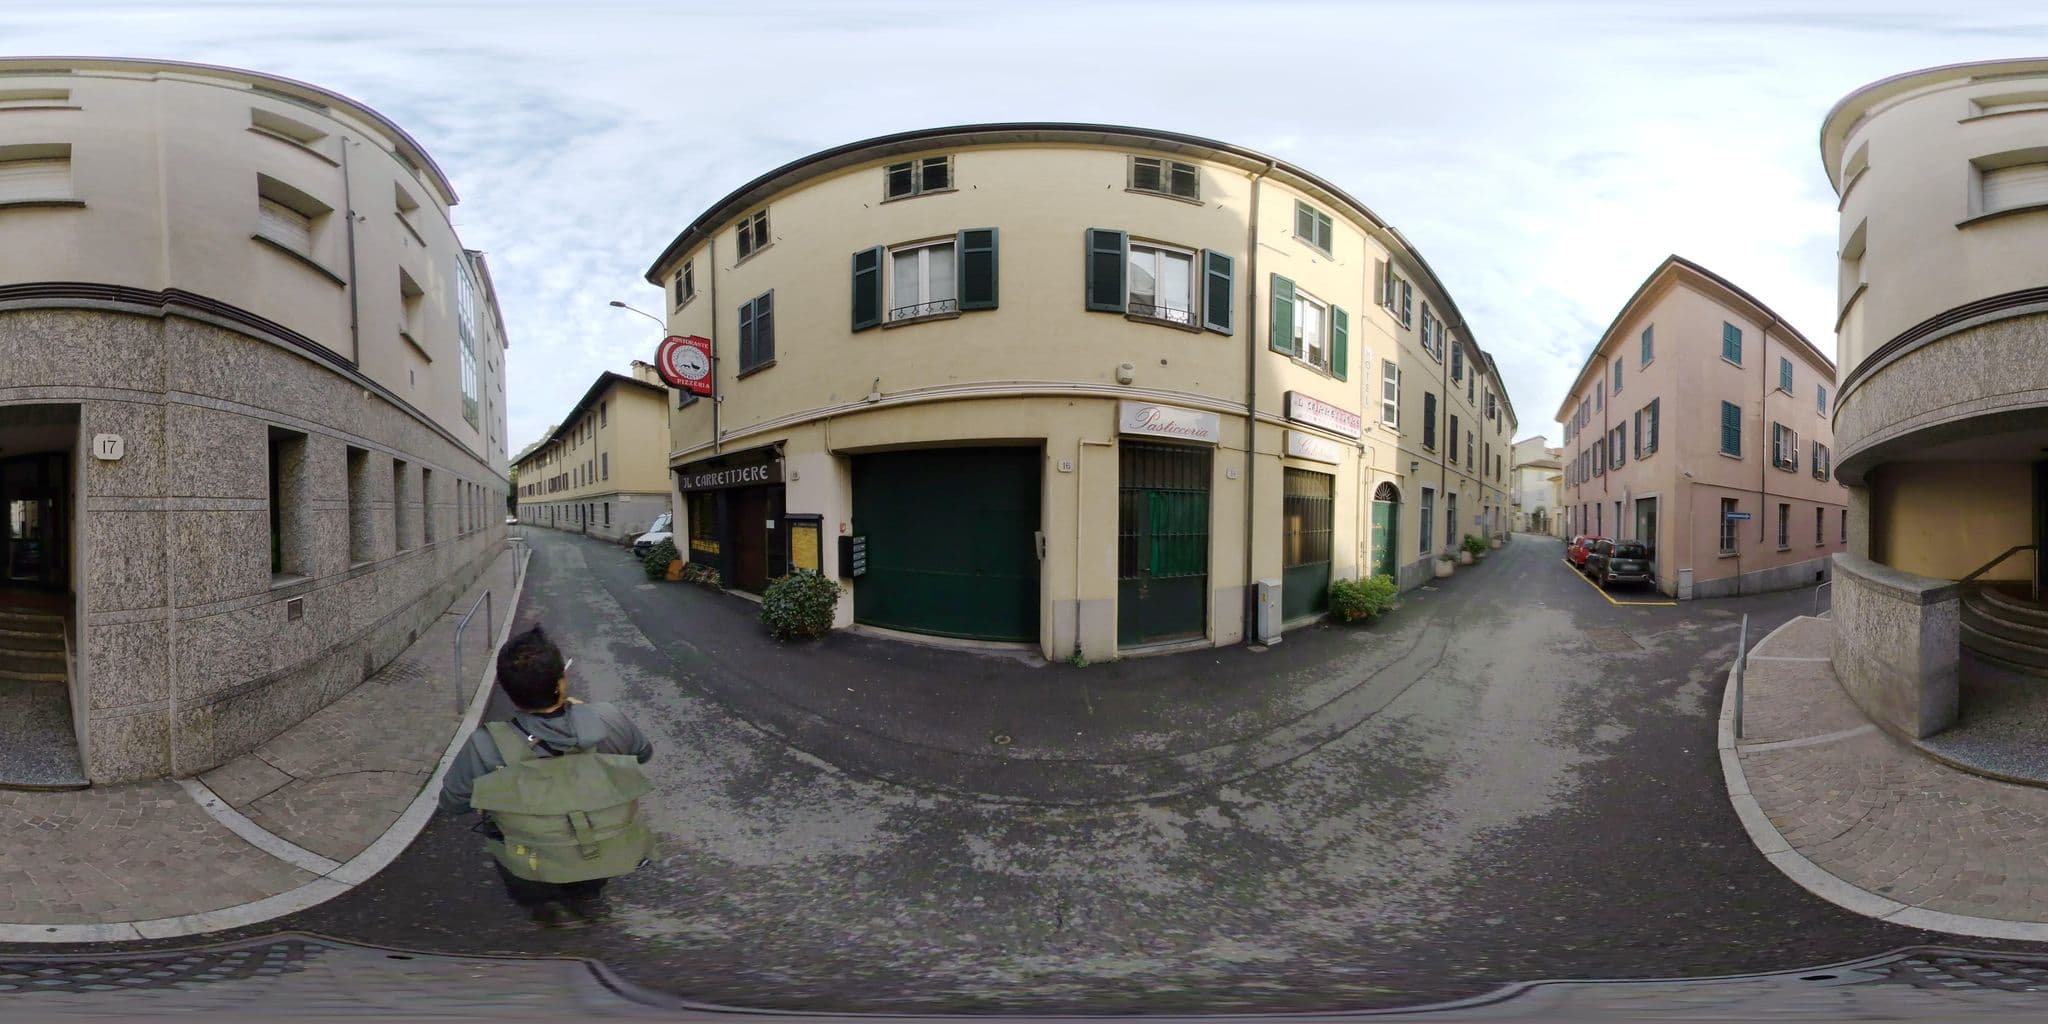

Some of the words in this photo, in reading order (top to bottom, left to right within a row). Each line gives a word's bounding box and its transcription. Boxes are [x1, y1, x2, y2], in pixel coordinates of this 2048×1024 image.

[677, 378, 710, 389] PIZZERIA
[1129, 407, 1209, 438] Pasticceria
[102, 440, 117, 454] 17
[1062, 461, 1071, 470] 16
[695, 465, 769, 487] CARRETTIERE
